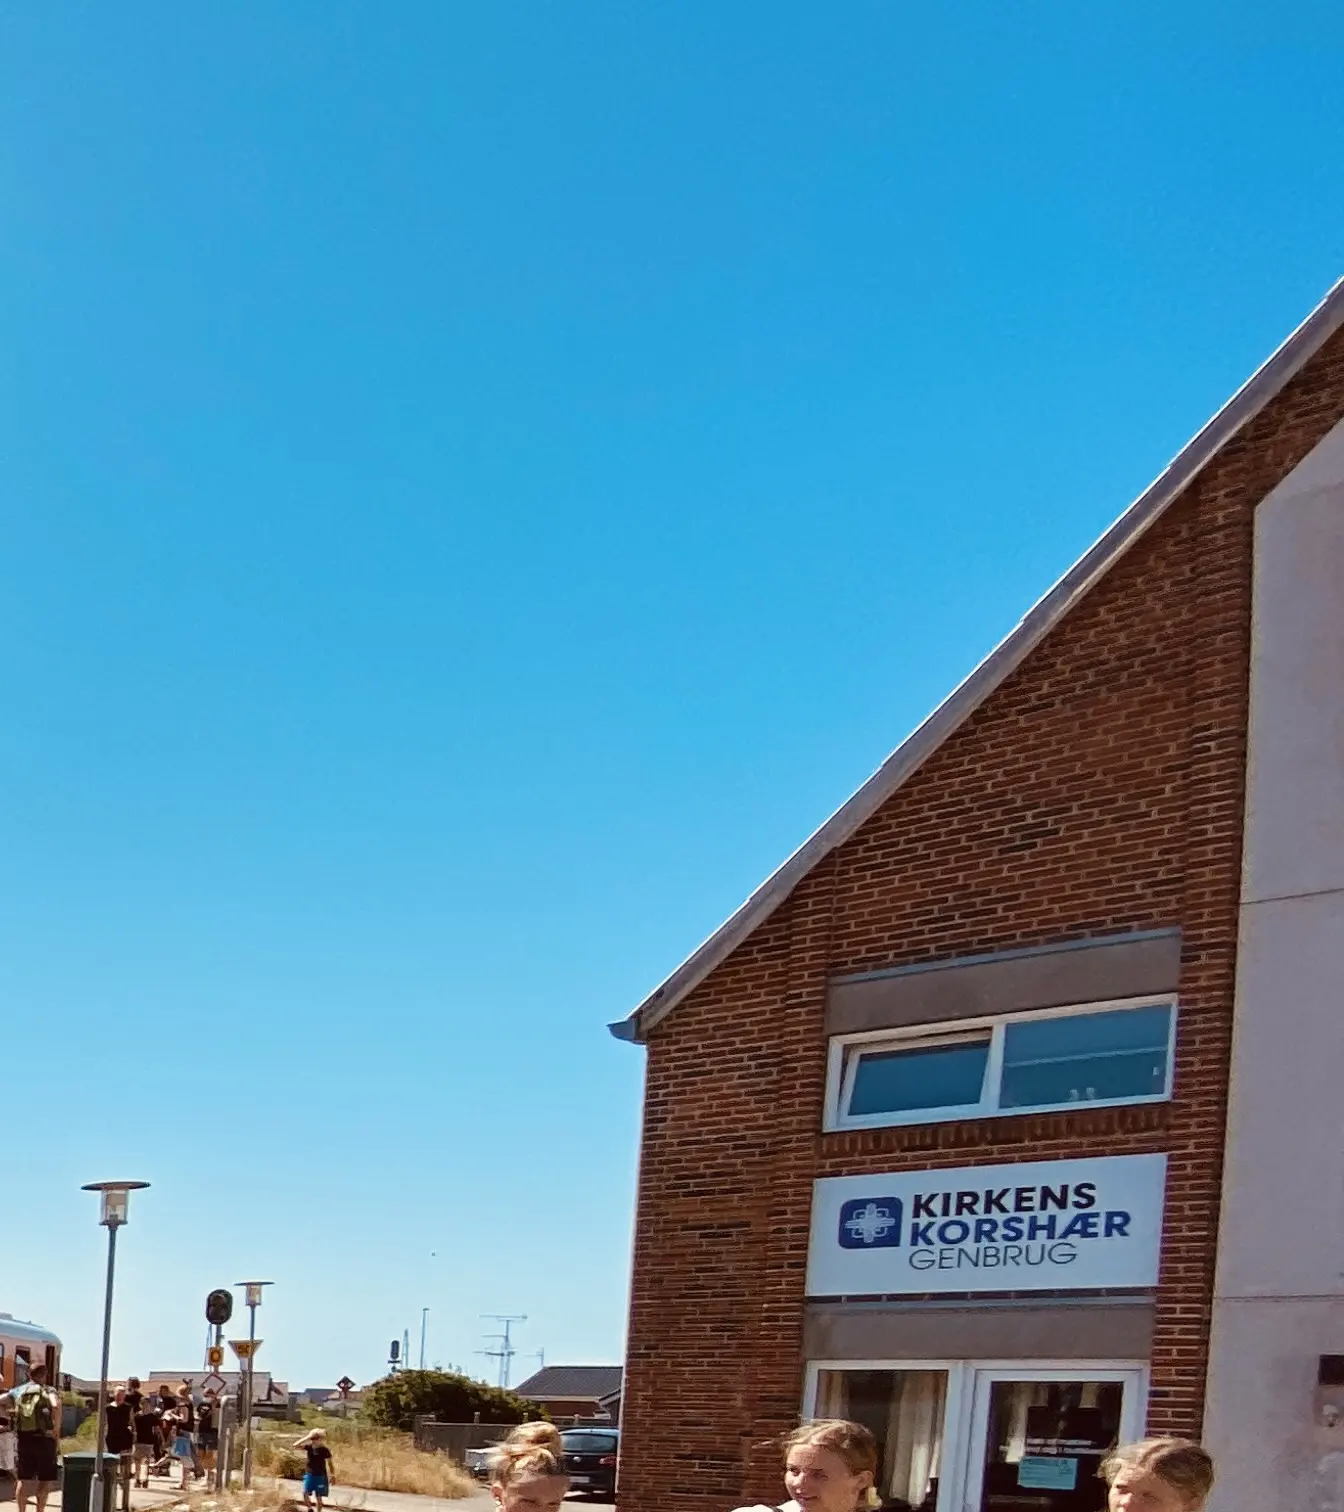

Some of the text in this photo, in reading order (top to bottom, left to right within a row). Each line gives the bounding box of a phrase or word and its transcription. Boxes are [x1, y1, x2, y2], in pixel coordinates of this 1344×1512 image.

[912, 1182, 1097, 1219] KIRKENS
[910, 1211, 1131, 1246] KORSHÆR
[909, 1242, 1078, 1270] GENBRUG
